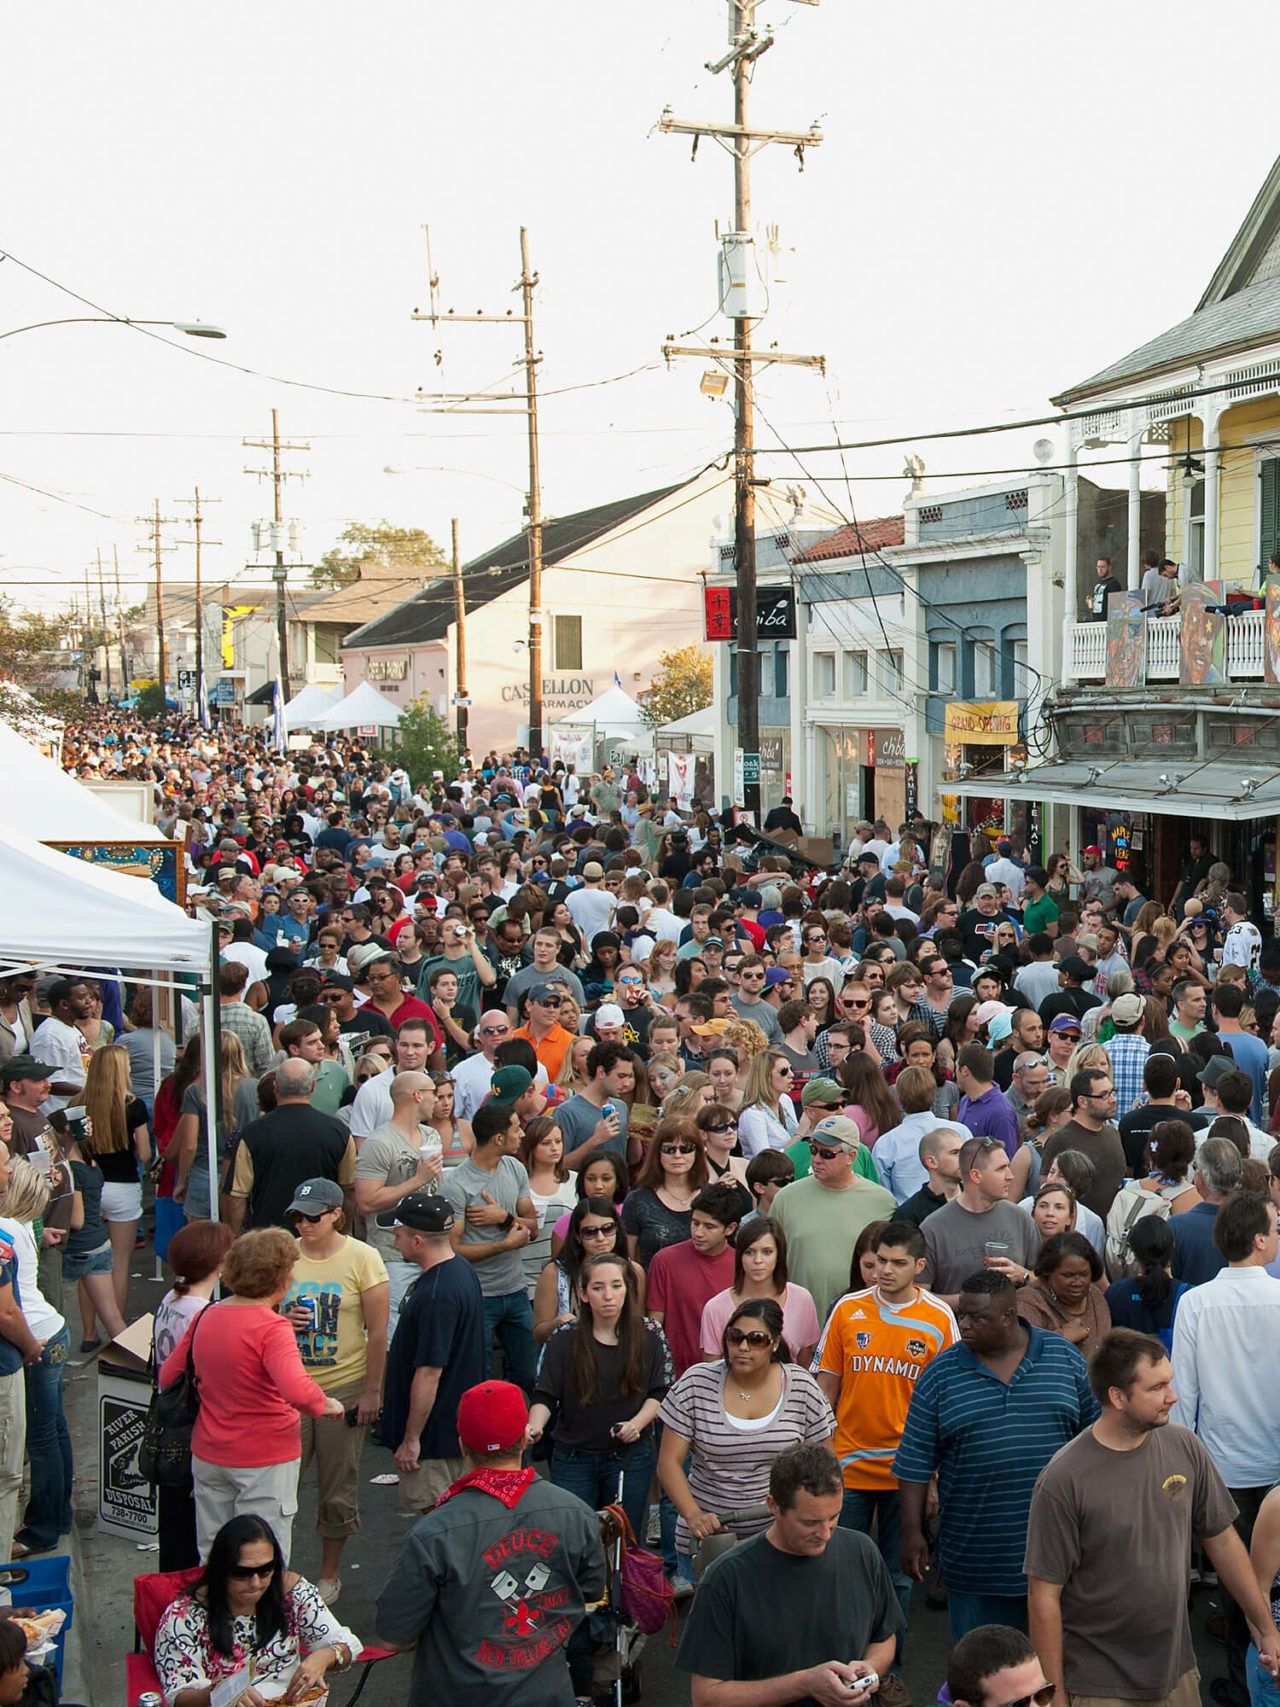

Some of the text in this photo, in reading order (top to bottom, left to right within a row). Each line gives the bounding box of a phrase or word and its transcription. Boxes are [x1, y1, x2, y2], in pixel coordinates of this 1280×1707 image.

[501, 678, 594, 702] CASELLON
[523, 698, 592, 709] PARMACY
[851, 1355, 922, 1380] DYNAMO
[106, 1409, 139, 1436] RIVER
[110, 1420, 146, 1451] PARISH
[105, 1488, 155, 1513] DISPOSAL
[111, 1506, 148, 1524] 738-7700
[486, 1531, 555, 1567] DEUCE
